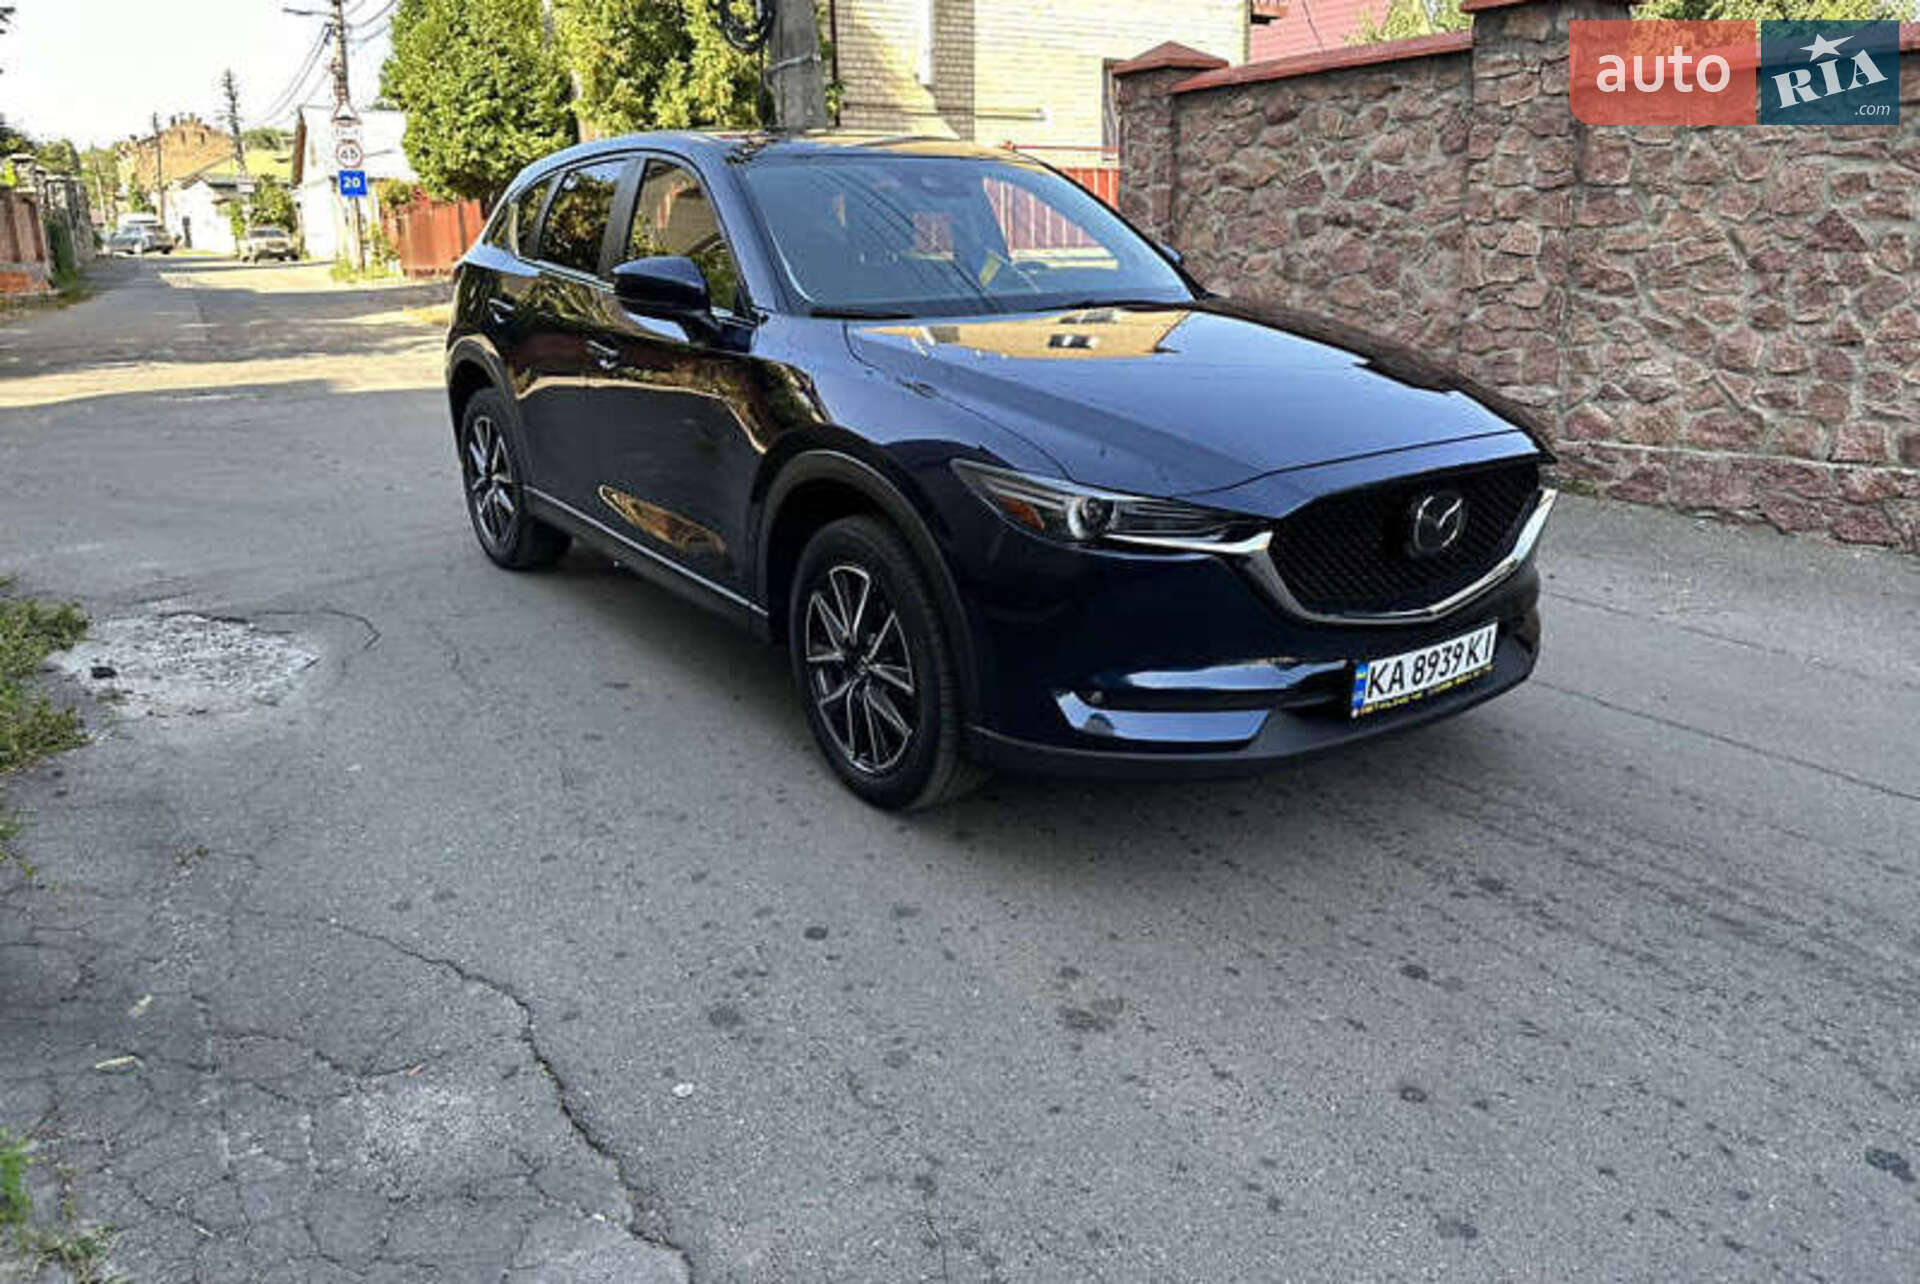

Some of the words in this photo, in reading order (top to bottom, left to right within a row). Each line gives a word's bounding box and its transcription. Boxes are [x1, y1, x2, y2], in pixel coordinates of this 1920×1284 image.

[343, 176, 361, 188] 20
[1367, 660, 1405, 699] KA
[1411, 641, 1464, 686] 8939
[1466, 628, 1492, 667] KI
